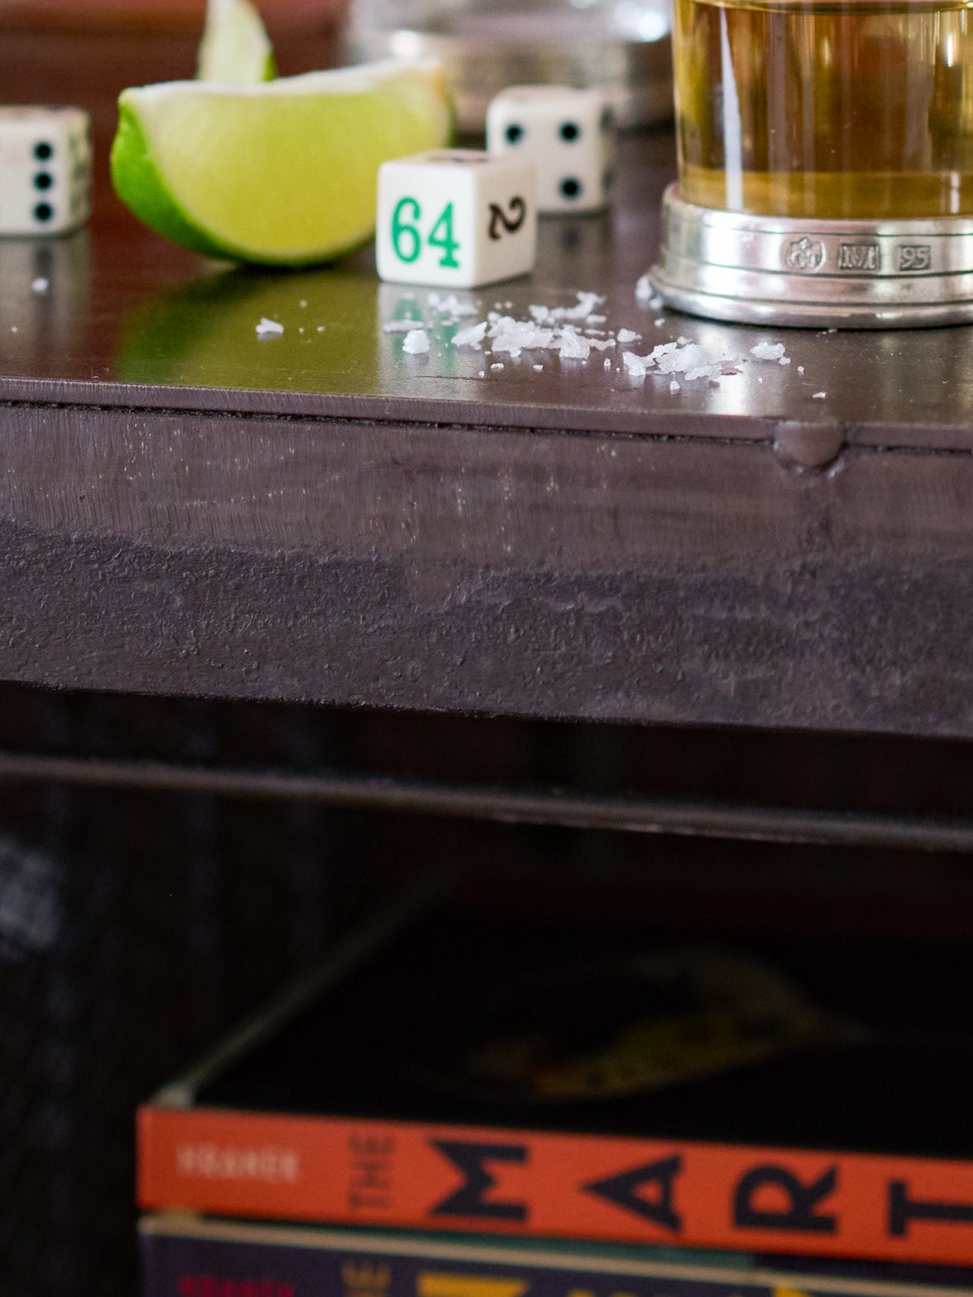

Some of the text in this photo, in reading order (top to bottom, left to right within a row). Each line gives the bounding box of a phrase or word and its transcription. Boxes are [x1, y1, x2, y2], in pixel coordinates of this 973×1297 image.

[391, 196, 460, 269] 64
[487, 195, 526, 241] 2
[900, 246, 931, 270] 95
[348, 1133, 394, 1211] THE
